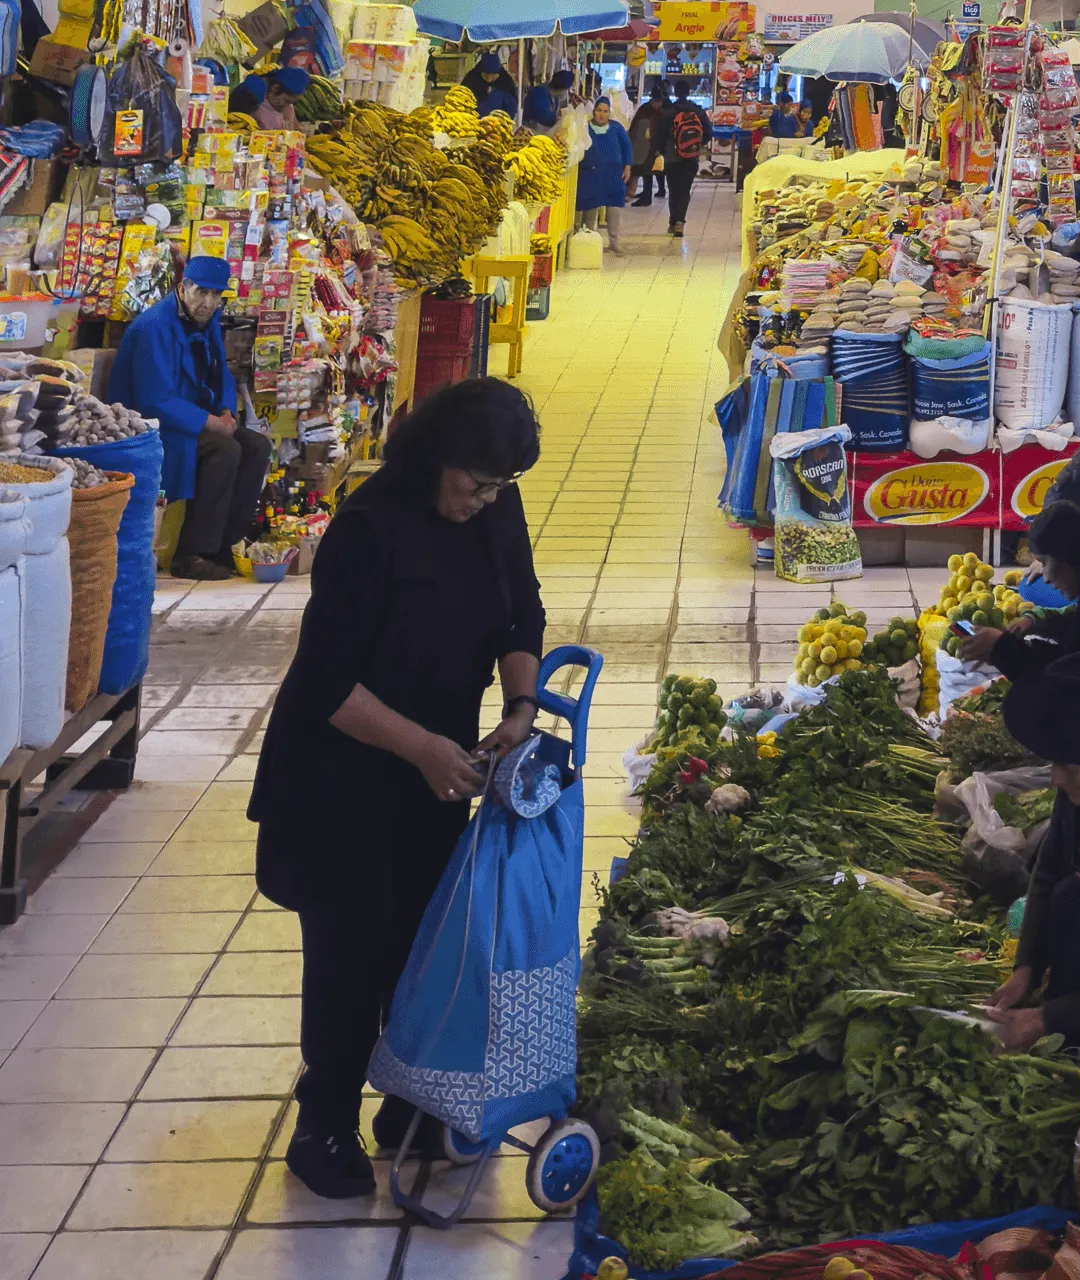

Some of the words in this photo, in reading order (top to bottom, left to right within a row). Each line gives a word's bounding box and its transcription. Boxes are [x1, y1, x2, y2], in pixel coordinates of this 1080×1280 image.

[860, 428, 878, 438] Sask.
[879, 428, 902, 438] Canada
[880, 478, 970, 510] Gusta
